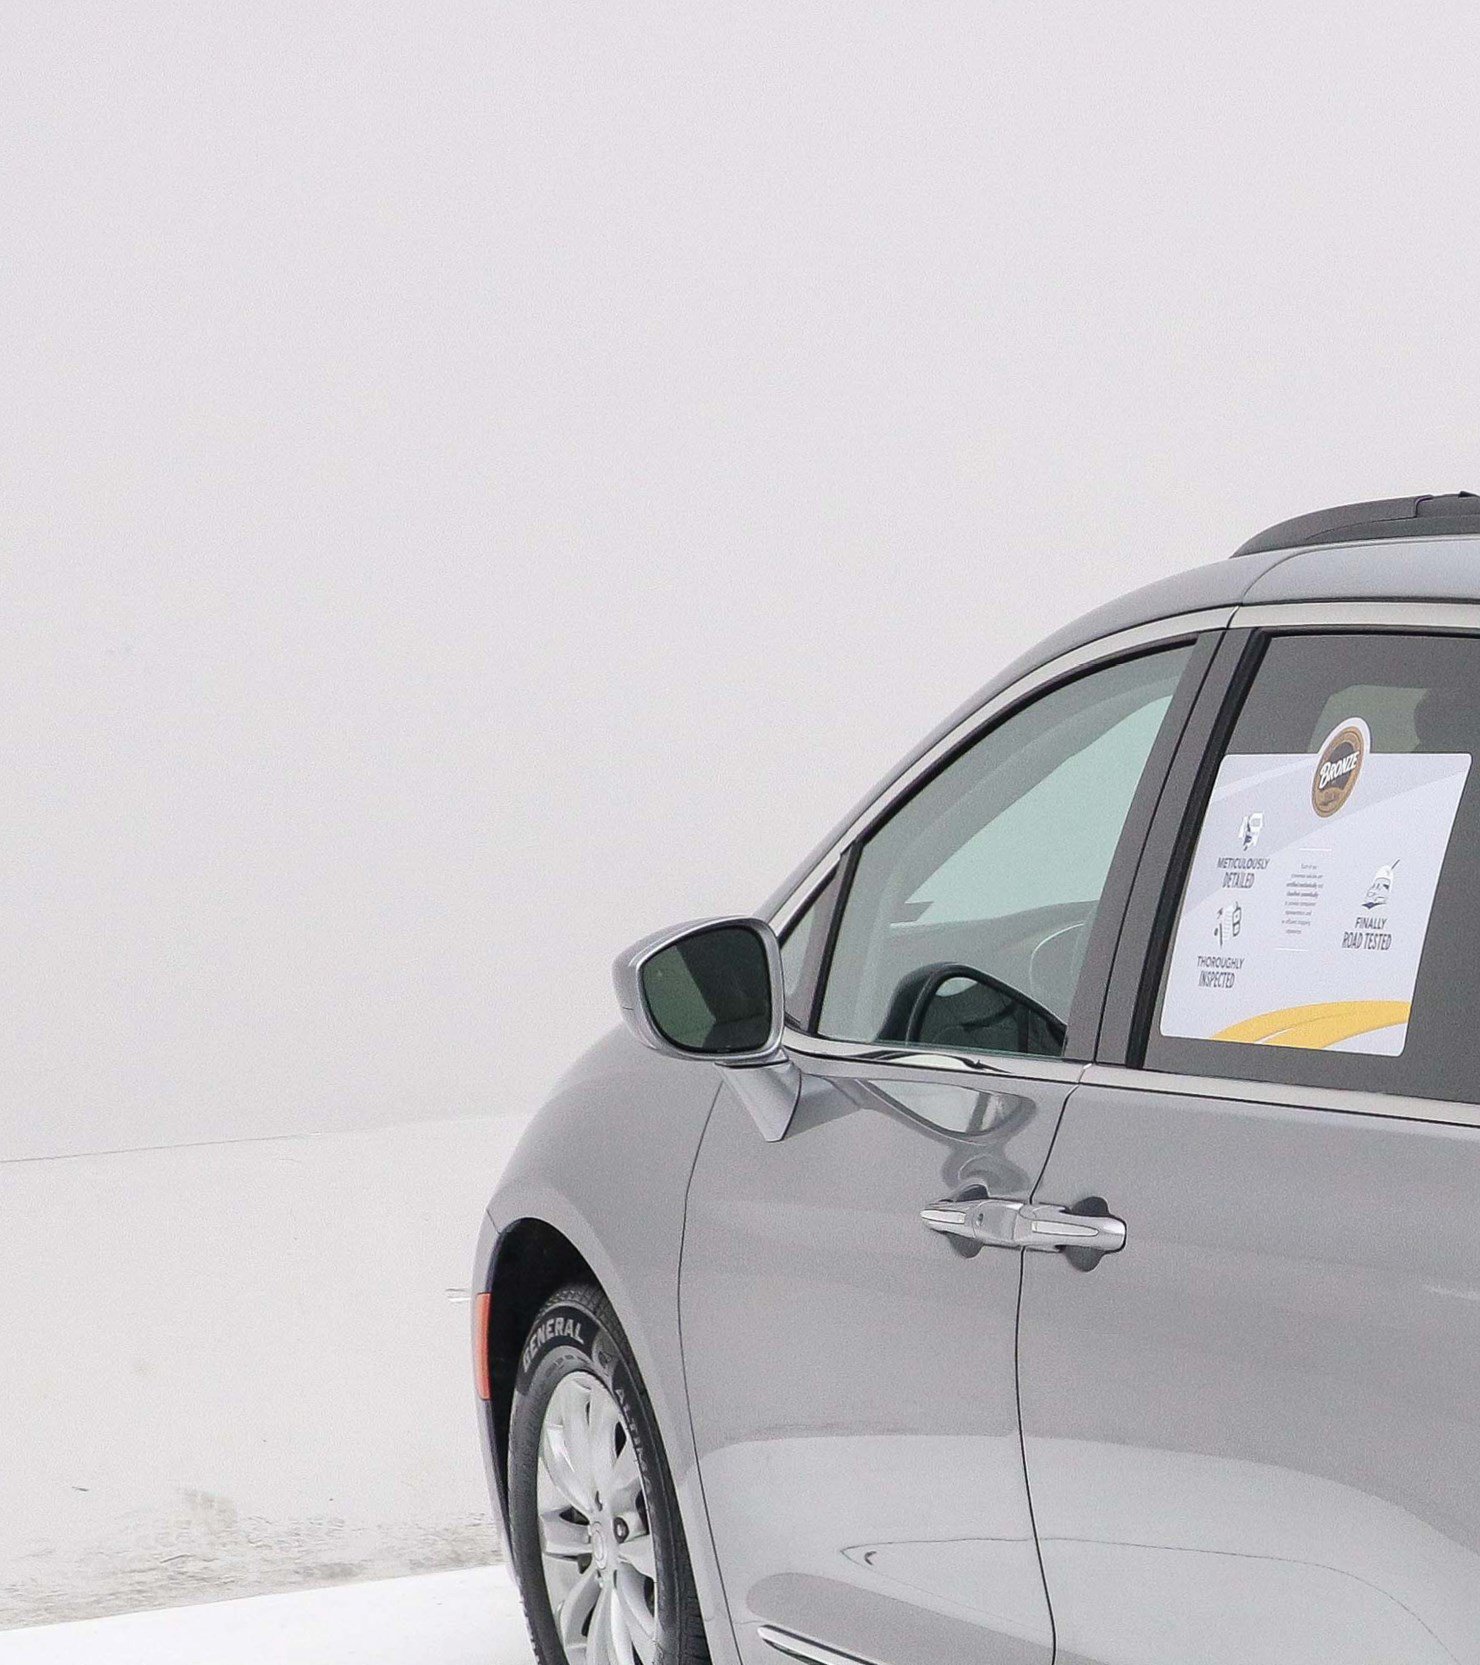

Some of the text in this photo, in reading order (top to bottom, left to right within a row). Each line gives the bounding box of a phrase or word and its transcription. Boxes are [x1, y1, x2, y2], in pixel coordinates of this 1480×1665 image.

[1319, 750, 1360, 790] BRONZE
[1217, 857, 1270, 870] METICULOUSLY
[1222, 872, 1254, 888] DETAILED
[1355, 917, 1387, 930] FINALLY
[1342, 931, 1392, 951] ROAD TESTED
[1197, 956, 1244, 970] THOROUGHLY
[1198, 971, 1235, 988] INSPECTED
[523, 1316, 585, 1373] GENERAL
